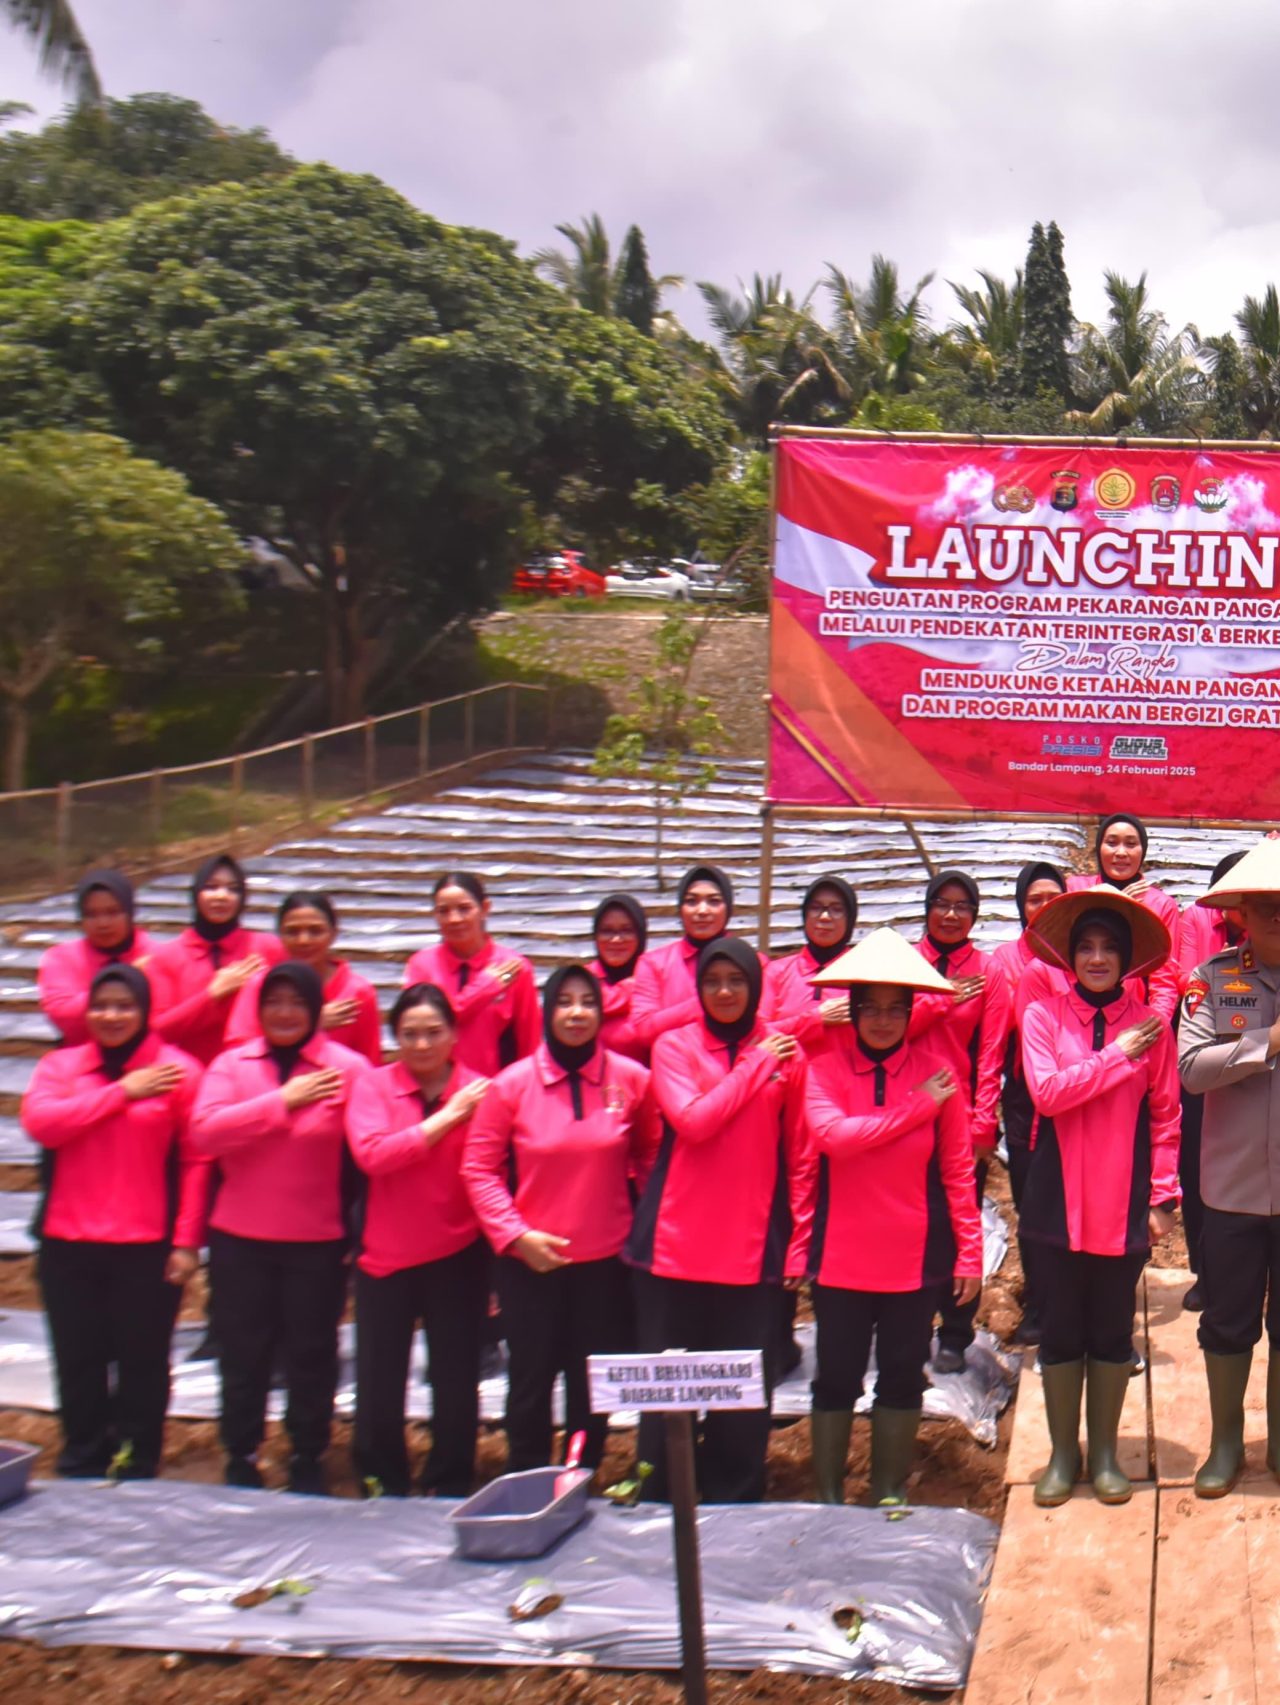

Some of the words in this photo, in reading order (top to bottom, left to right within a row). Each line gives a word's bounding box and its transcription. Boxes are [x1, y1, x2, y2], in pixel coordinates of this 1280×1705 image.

[829, 590, 953, 610] PENGUATAN
[958, 594, 1061, 613] PROGRAM
[1066, 597, 1209, 617] PEKARANGAN
[823, 616, 905, 634] MELALUI
[910, 619, 1047, 638] PENDEKATAN
[1052, 623, 1195, 643] TERINTEGRASI
[1201, 628, 1213, 643] &
[1016, 643, 1103, 671] Dalam
[1110, 644, 1176, 693] Rangka
[924, 672, 1058, 692] MENDUKUNG
[1062, 675, 1197, 696] KETAHANAN
[906, 697, 951, 714] DAN
[955, 700, 1058, 718] PROGRAM
[1062, 703, 1141, 720] MAKAN
[1146, 705, 1223, 723] BERGIZI
[1043, 735, 1100, 744] POSKO
[1115, 737, 1163, 748] GUGUS
[1008, 761, 1048, 771] Bandar
[1050, 762, 1104, 775] Lampung,
[1107, 764, 1120, 773] 24
[1122, 764, 1168, 775] Februari
[1170, 766, 1196, 776] 2025
[1219, 996, 1257, 1008] HELMY
